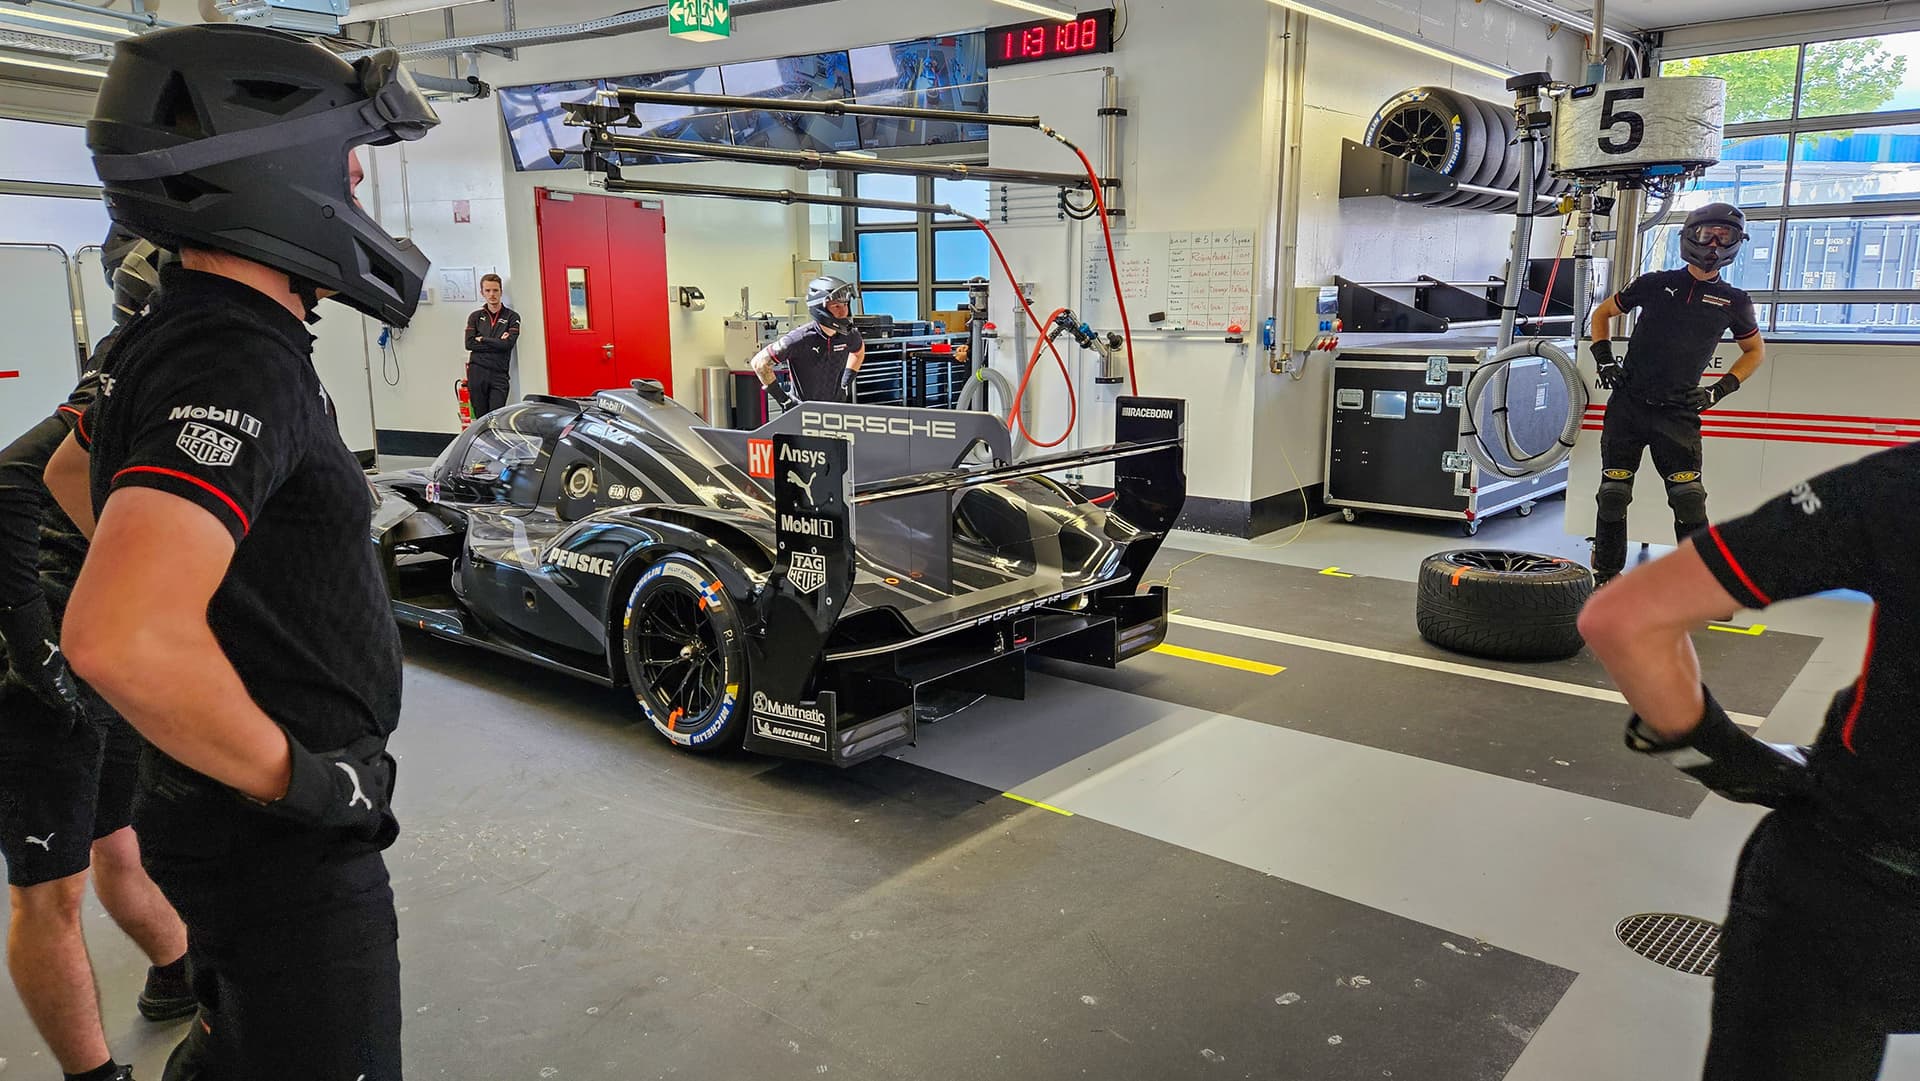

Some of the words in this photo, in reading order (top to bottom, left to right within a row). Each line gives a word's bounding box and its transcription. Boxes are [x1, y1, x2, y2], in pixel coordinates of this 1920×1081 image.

[1006, 18, 1097, 59] 11:31:08
[1364, 116, 1381, 147] CHELIN
[1598, 87, 1645, 155] 5
[1443, 130, 1462, 175] MICHELIN
[168, 405, 240, 426] Mobil
[599, 398, 619, 411] Mobil
[1129, 407, 1173, 419] RACEBORN
[190, 424, 236, 451] TAG
[802, 411, 956, 439] PORSCHE
[180, 436, 231, 462] HEUER
[750, 442, 771, 475] HY
[779, 443, 826, 467] Ansys
[1791, 483, 1822, 515] sys
[781, 514, 818, 535] Mobil
[547, 547, 614, 578] PENSKE
[794, 555, 823, 570] TAG
[789, 570, 824, 590] HEUER
[978, 593, 1069, 626] PORSCHE
[693, 706, 730, 744] MICHELIN
[767, 700, 826, 724] Multimatic
[772, 727, 821, 744] MICHELIN
